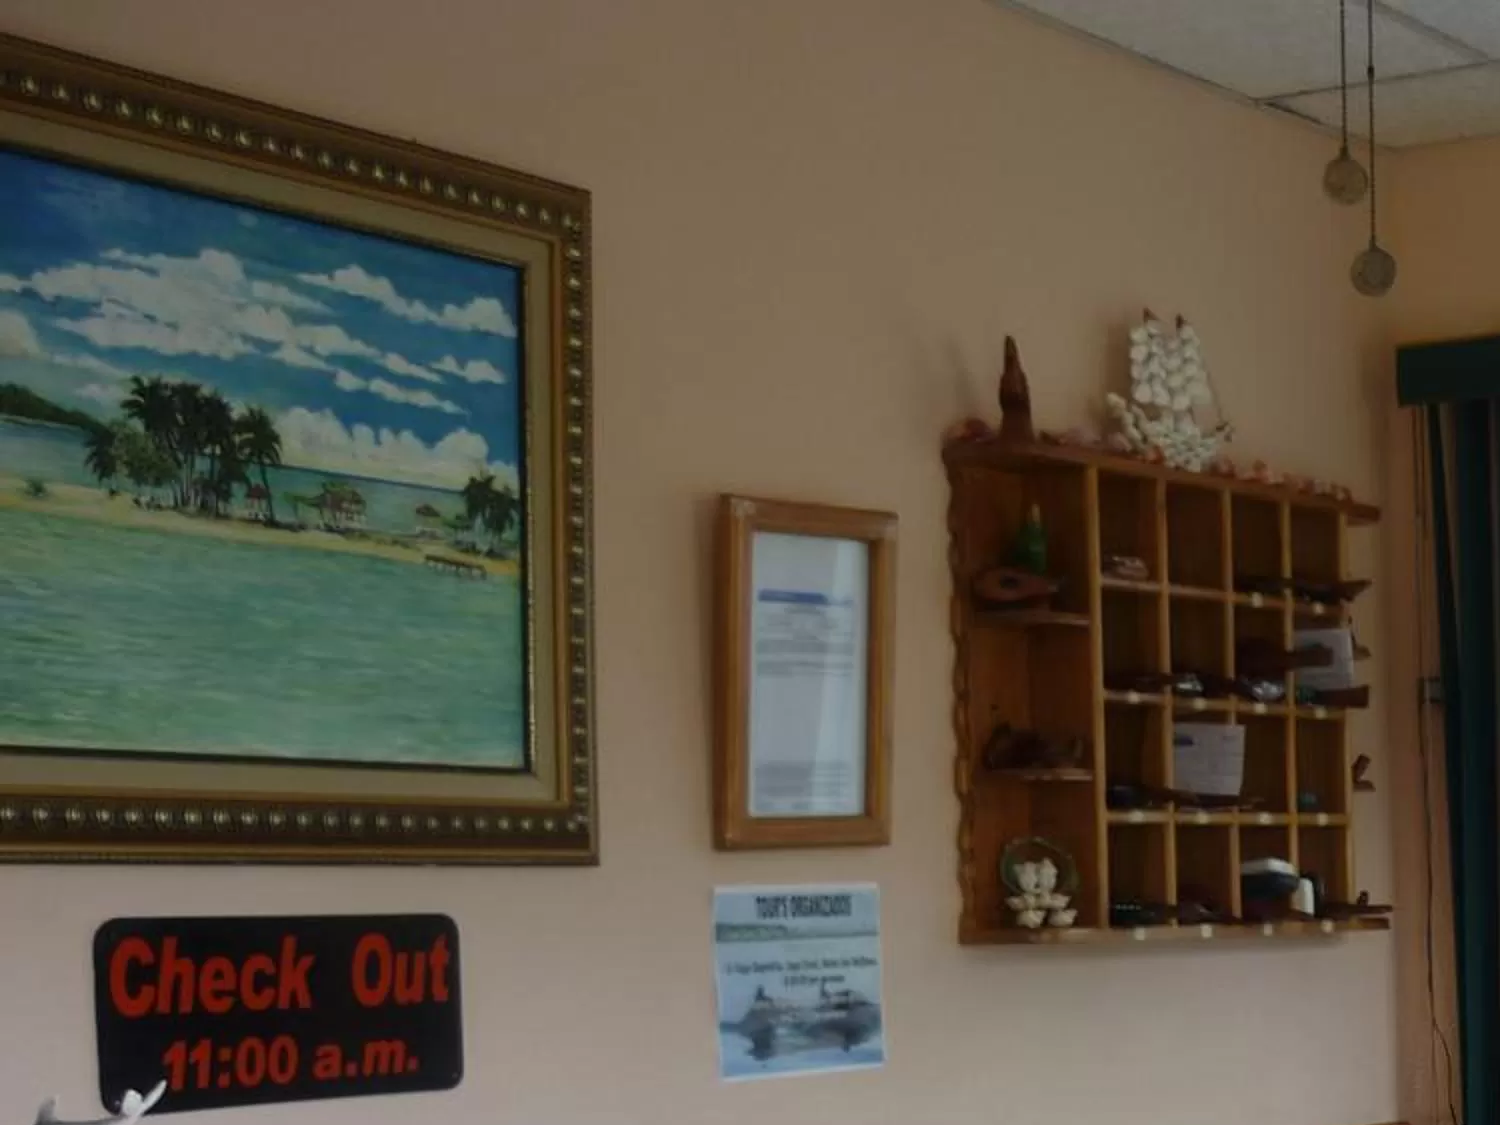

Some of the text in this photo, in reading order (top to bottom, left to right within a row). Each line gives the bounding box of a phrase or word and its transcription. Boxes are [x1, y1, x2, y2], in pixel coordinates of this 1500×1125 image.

[108, 932, 450, 1019] Check Out
[162, 1035, 419, 1092] 11:00 a.m.
